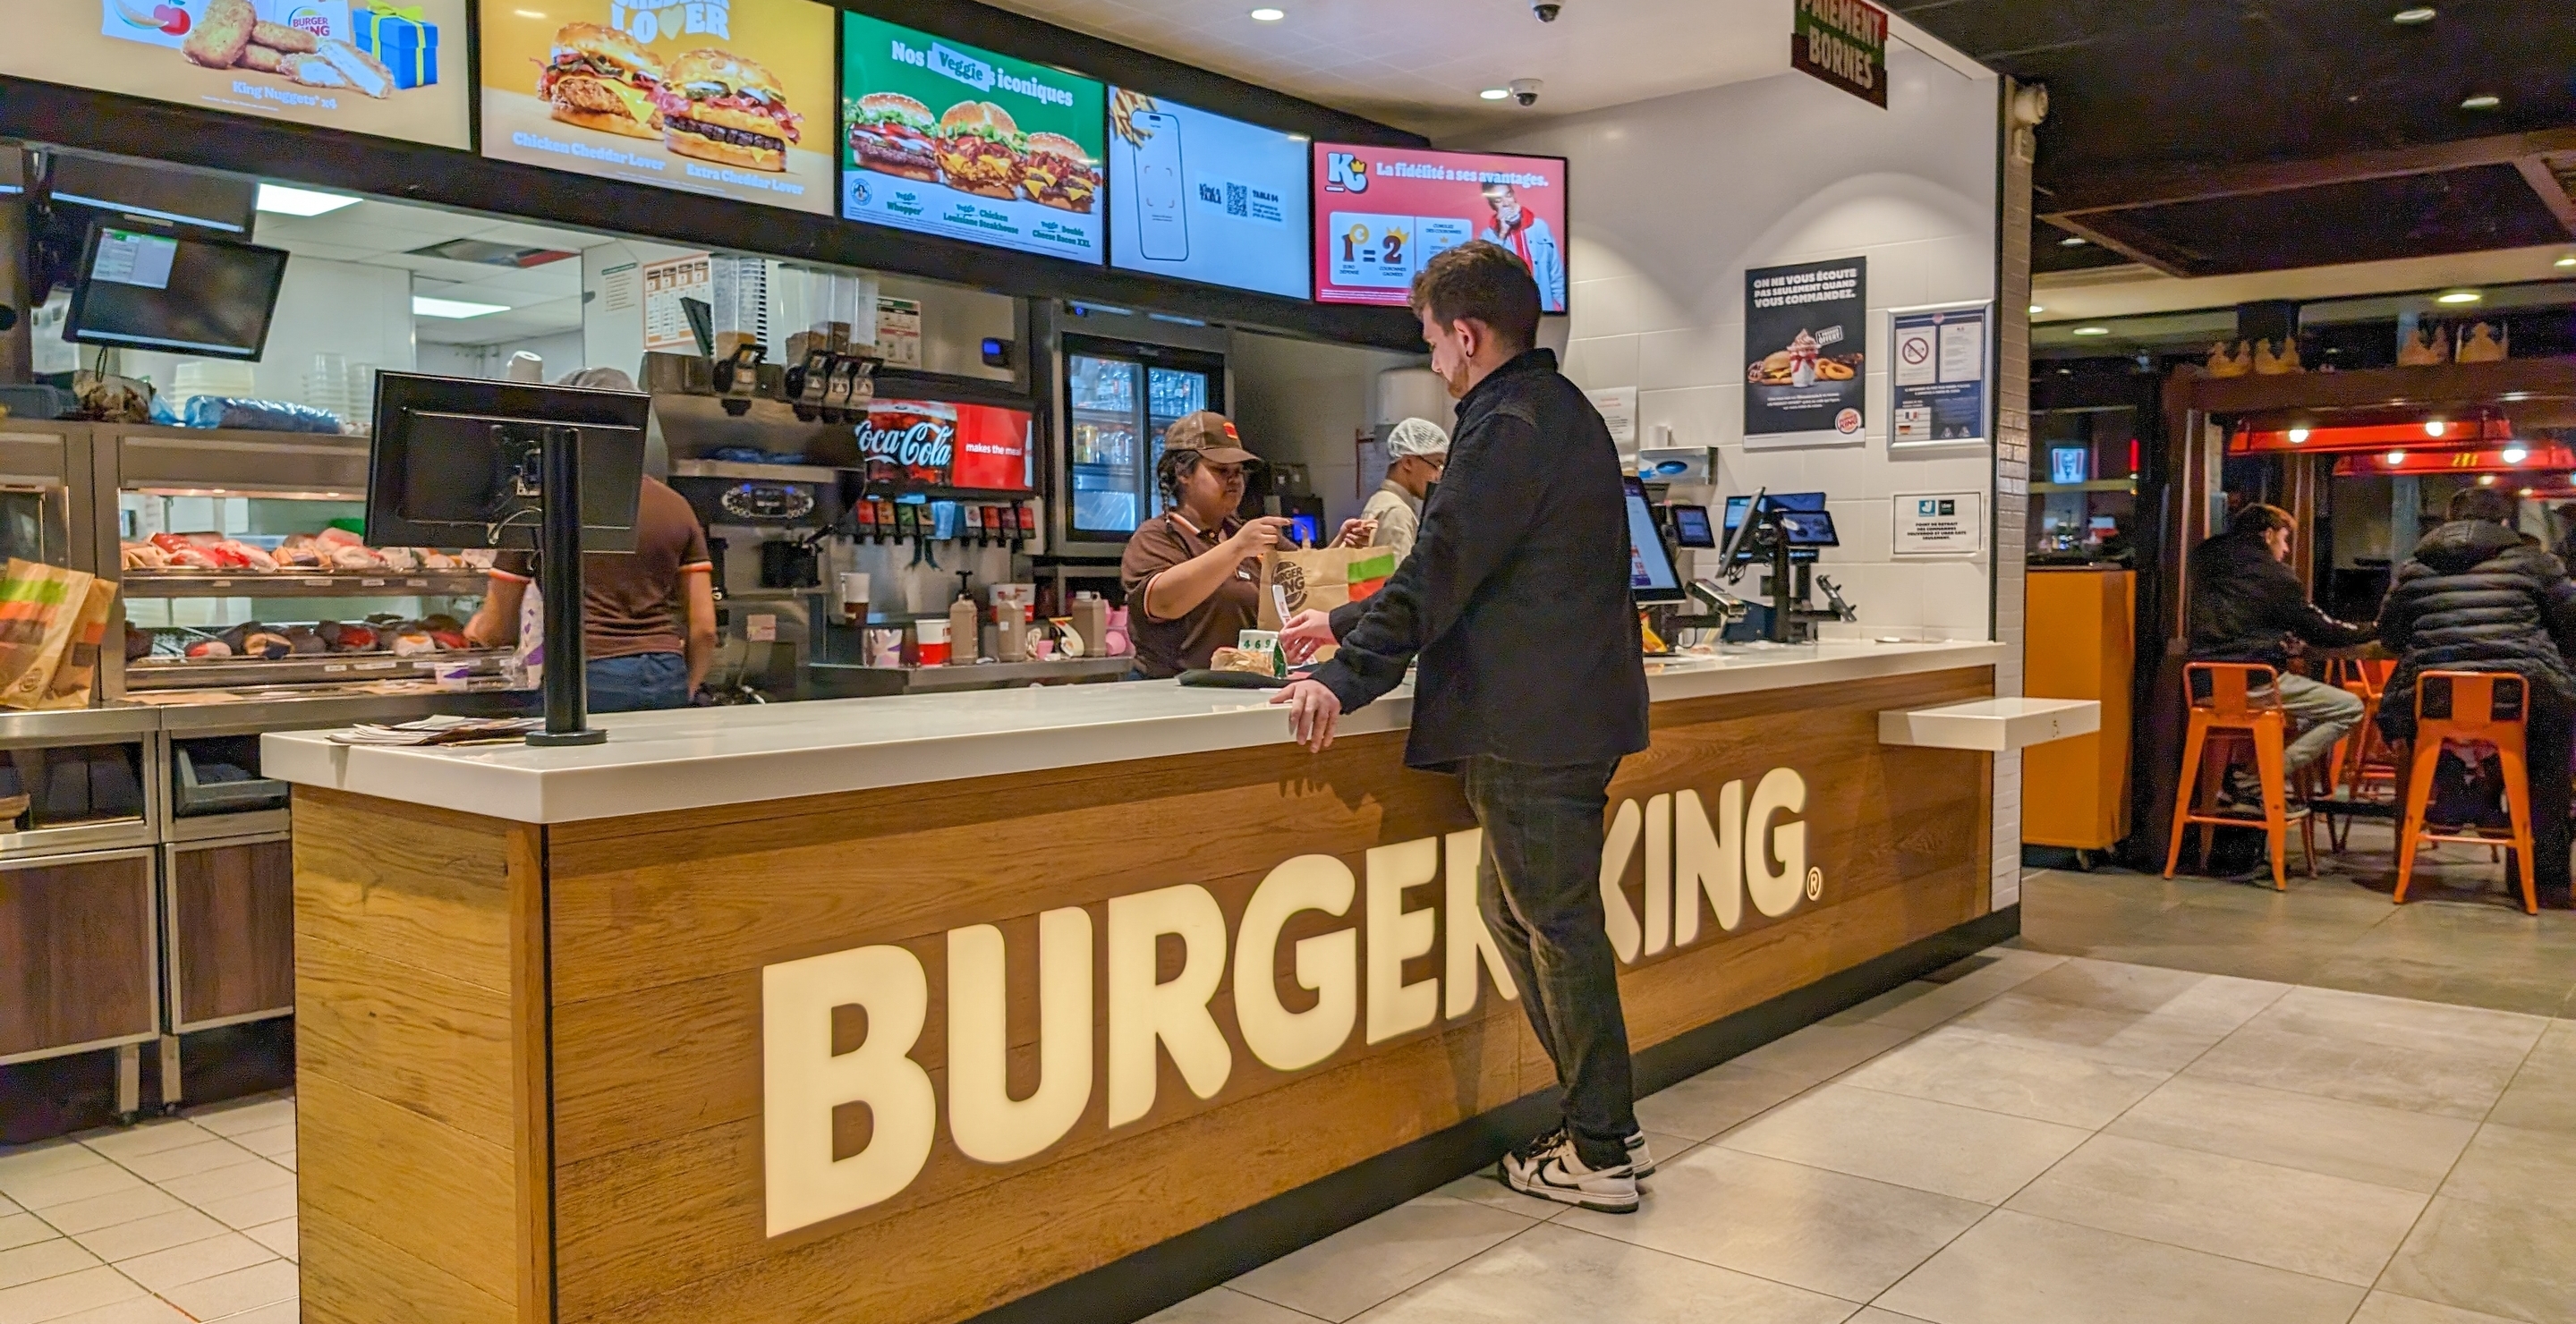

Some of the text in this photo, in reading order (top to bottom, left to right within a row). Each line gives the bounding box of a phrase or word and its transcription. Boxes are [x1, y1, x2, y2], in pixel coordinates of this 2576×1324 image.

[293, 17, 328, 27] BURGER
[891, 40, 925, 67] Nos
[1809, 24, 1874, 89] BORNES
[939, 51, 983, 81] Veggie
[233, 81, 263, 99] King
[997, 68, 1074, 107] iconiques
[512, 131, 666, 171] Chicken Cheddar Lover
[686, 163, 720, 181] Extra
[721, 169, 770, 189] Cheddar
[771, 179, 804, 195] Lover
[1376, 161, 1549, 189] La fidélité a ses avantages.
[979, 208, 1008, 223] Chicken
[979, 219, 1019, 234] Steakhouse
[1032, 229, 1056, 242] Cheese
[1341, 233, 1355, 262] 1
[1382, 234, 1402, 264] 2
[1754, 268, 1858, 288] ON NE VOUS ÉCOUTE
[1754, 279, 1857, 298] PAS SEULEMENT QUAND
[1754, 288, 1857, 308] VOUS COMMANDEZ.
[965, 443, 991, 454] makes
[992, 445, 1005, 454] the
[1280, 576, 1305, 596] NG
[761, 828, 1523, 1240] BURGER
